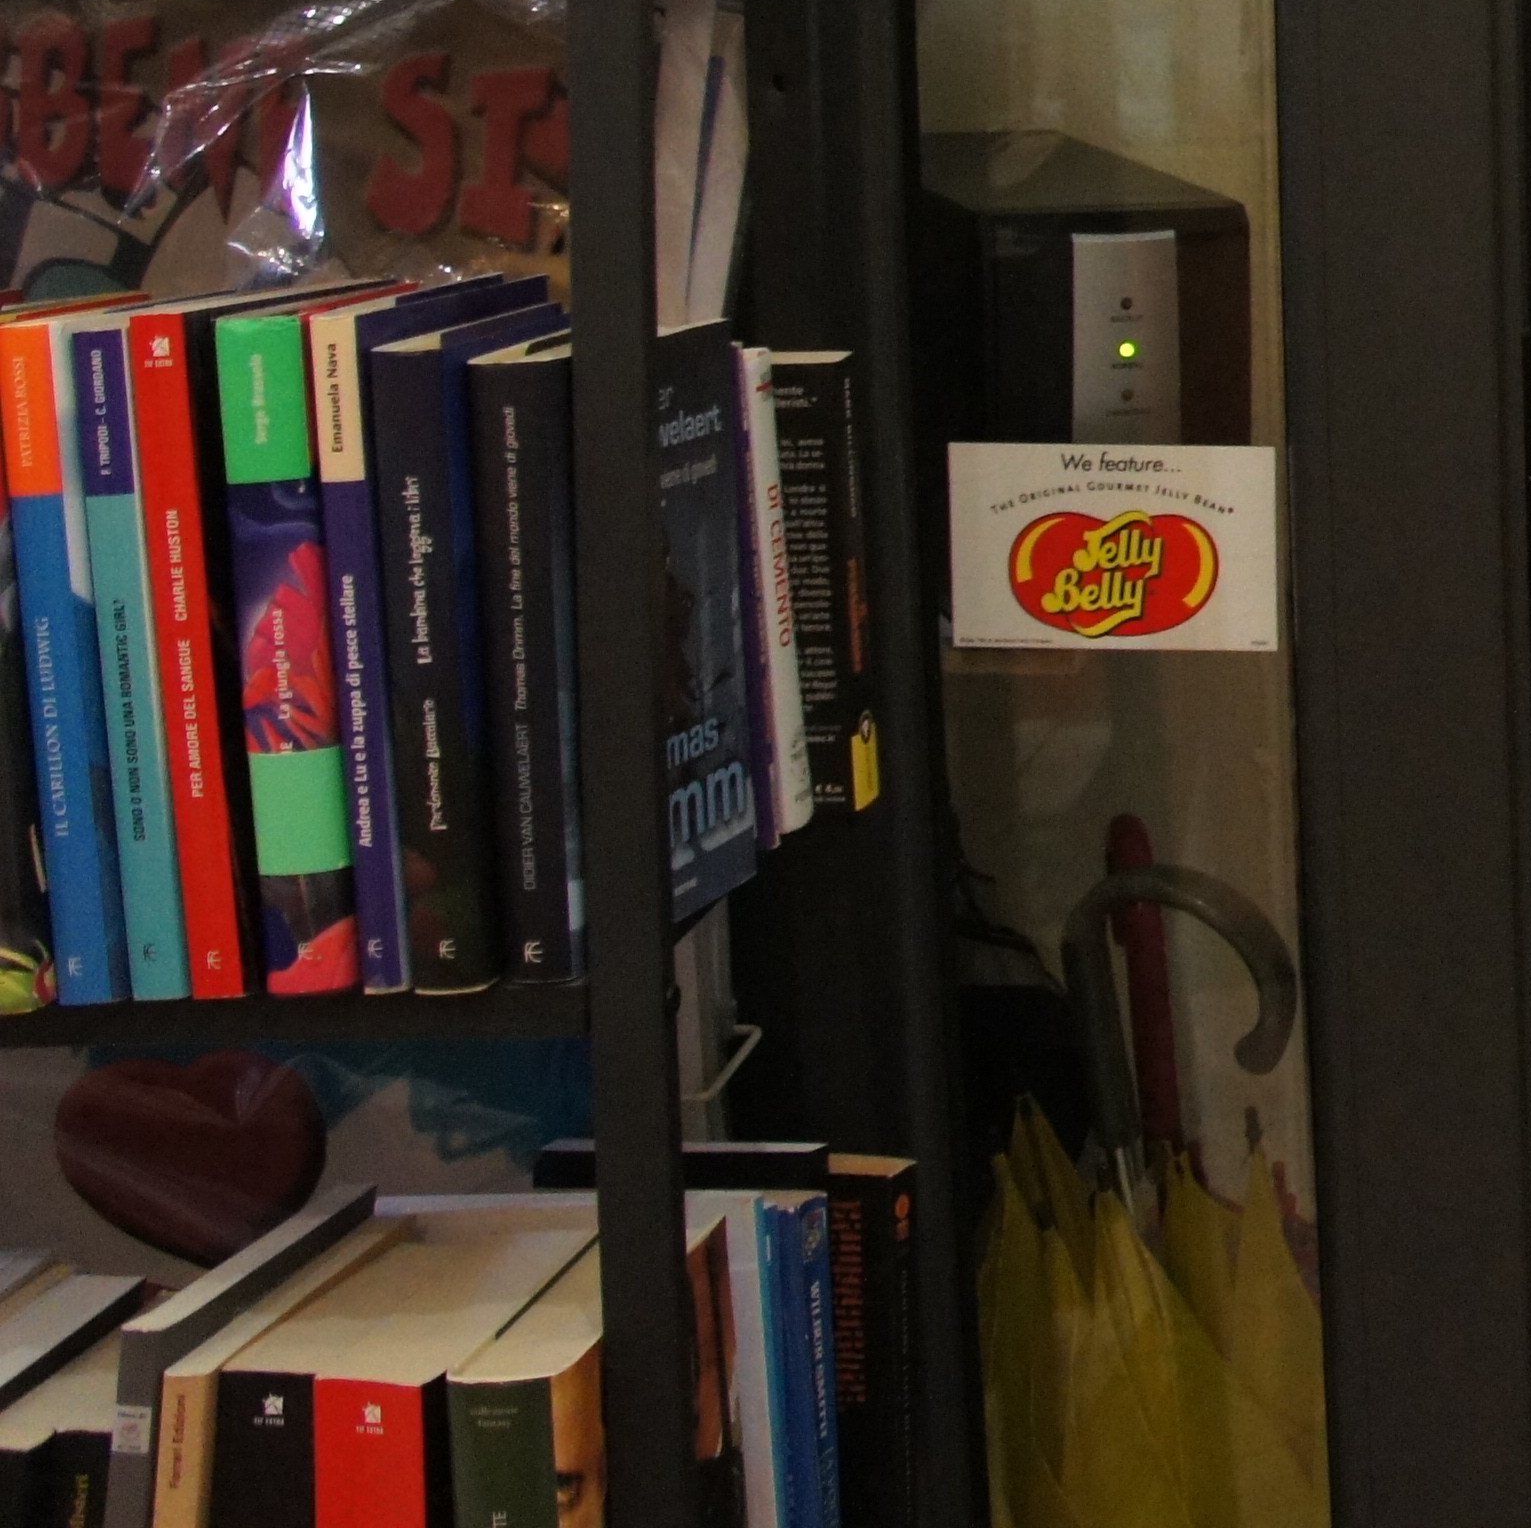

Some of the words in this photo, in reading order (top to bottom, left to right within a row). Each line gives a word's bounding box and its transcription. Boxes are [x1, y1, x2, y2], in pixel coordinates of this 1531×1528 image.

[12, 355, 29, 400] ROSSI
[326, 343, 338, 379] Nava
[14, 404, 33, 469] PATRIZIA
[327, 383, 344, 453] Emanuela
[506, 466, 518, 498] viene
[1061, 453, 1092, 472] We
[767, 483, 781, 512] DI
[990, 499, 1015, 515] THE
[1018, 484, 1082, 504] ORIGINAL
[1086, 480, 1150, 493] GOURMET
[1154, 484, 1190, 501] JELLY
[165, 509, 182, 564] HUSTON
[506, 501, 520, 544] mondo
[508, 546, 521, 566] del
[1073, 527, 1163, 579] Jelly
[171, 566, 188, 622] CHARLIE
[339, 574, 357, 626] stellare
[508, 569, 522, 591] fine
[769, 519, 794, 649] CEMENTO
[1041, 568, 1146, 620] Belly
[511, 594, 523, 610] La
[272, 608, 286, 646] rossa
[34, 615, 56, 694] LUDWIG
[114, 635, 133, 699] ROMANTIC
[177, 638, 194, 693] SANGUE
[344, 628, 365, 671] pesce
[416, 645, 434, 665] La
[272, 648, 293, 700] giungla
[345, 672, 361, 686] di
[514, 663, 527, 712] Thomas
[41, 697, 59, 719] DI
[120, 700, 136, 729] UNA
[183, 695, 197, 720] DEL
[277, 705, 291, 721] La
[349, 689, 369, 732] zuppa
[123, 729, 140, 764] SONO
[185, 722, 202, 770] AMORE
[349, 733, 366, 749] la
[666, 716, 720, 767] mas
[44, 723, 69, 817] CARILLON
[128, 767, 143, 798] NON
[191, 770, 204, 799] PER
[353, 763, 369, 784] Lu
[514, 723, 532, 814] CAUWELAERT
[54, 819, 70, 839] IL
[133, 812, 146, 842] SONO
[355, 797, 373, 848] Andrea
[519, 816, 533, 846] VAN
[522, 851, 537, 891] DIDIER
[810, 1279, 826, 1361] WILBUR
[814, 1364, 829, 1439] SMITH
